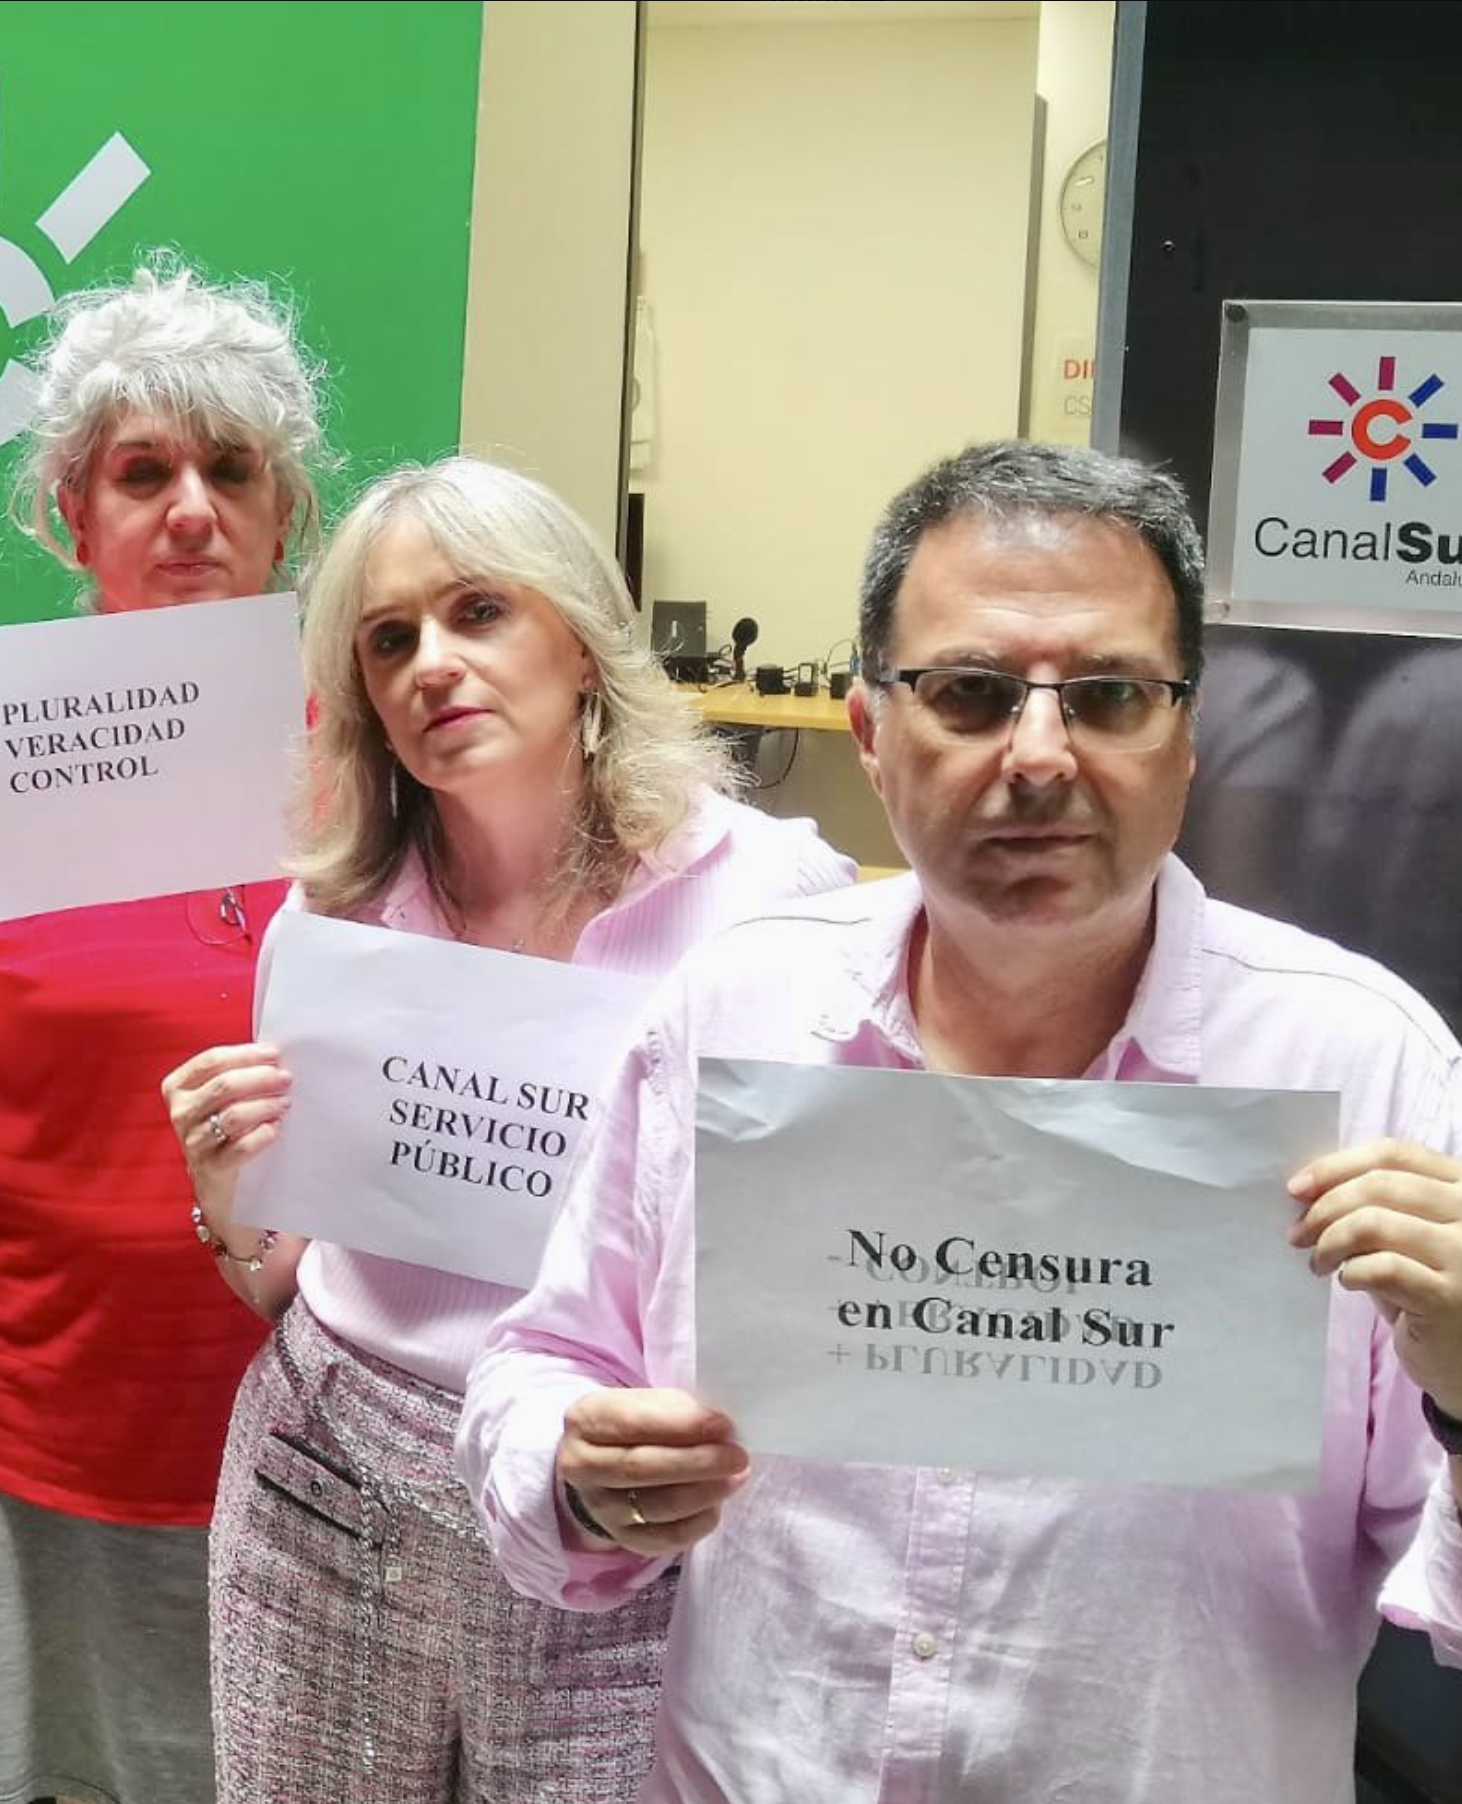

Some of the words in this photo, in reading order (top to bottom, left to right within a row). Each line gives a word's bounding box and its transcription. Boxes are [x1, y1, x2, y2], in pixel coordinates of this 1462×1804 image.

[1064, 360, 1095, 379] DI
[2, 681, 199, 726] PLURALIDAD
[5, 718, 185, 759] VERACIDAD
[10, 755, 158, 793] CONTROL
[382, 1056, 508, 1105] CANAL
[516, 1082, 590, 1121] SUR
[389, 1099, 566, 1157] SERVICIO
[391, 1139, 552, 1197] PÚBLICO
[847, 1229, 917, 1272] No
[936, 1237, 1152, 1286] Censura
[838, 1299, 892, 1330] en
[912, 1297, 1061, 1344] Canal
[1082, 1308, 1175, 1349] Sur
